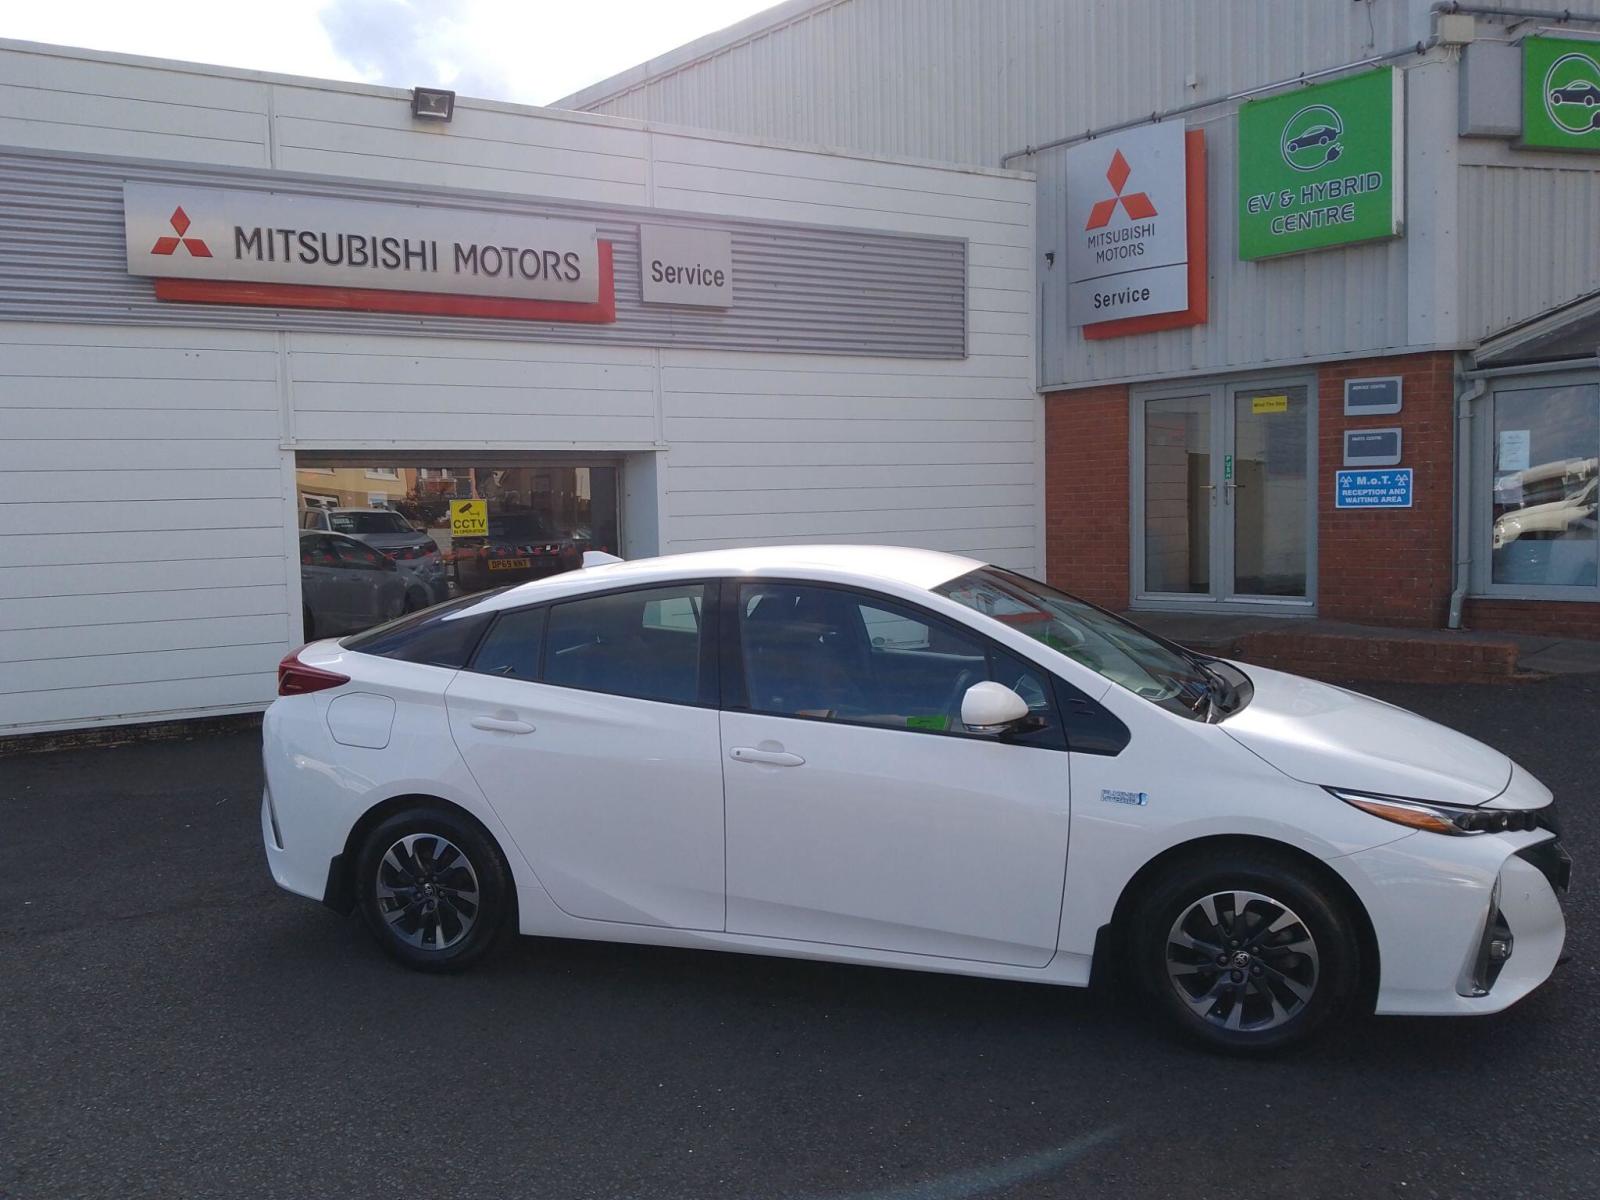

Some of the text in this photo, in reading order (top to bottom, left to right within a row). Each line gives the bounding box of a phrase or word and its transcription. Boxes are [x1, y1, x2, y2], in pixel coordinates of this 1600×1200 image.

[1247, 172, 1383, 214] EV & HYBRID
[1271, 202, 1355, 235] CENTRE
[1087, 223, 1155, 249] MITSUBISHI
[234, 226, 581, 281] MITSUBISHI MOTORS
[1096, 242, 1145, 264] MOTORS
[651, 260, 725, 288] Service
[1094, 287, 1150, 309] Service
[1342, 487, 1406, 496] RECEPTION AND
[1356, 475, 1392, 486] M.o.T.
[1345, 495, 1402, 504] WAITING AREA
[453, 518, 485, 529] CCTV
